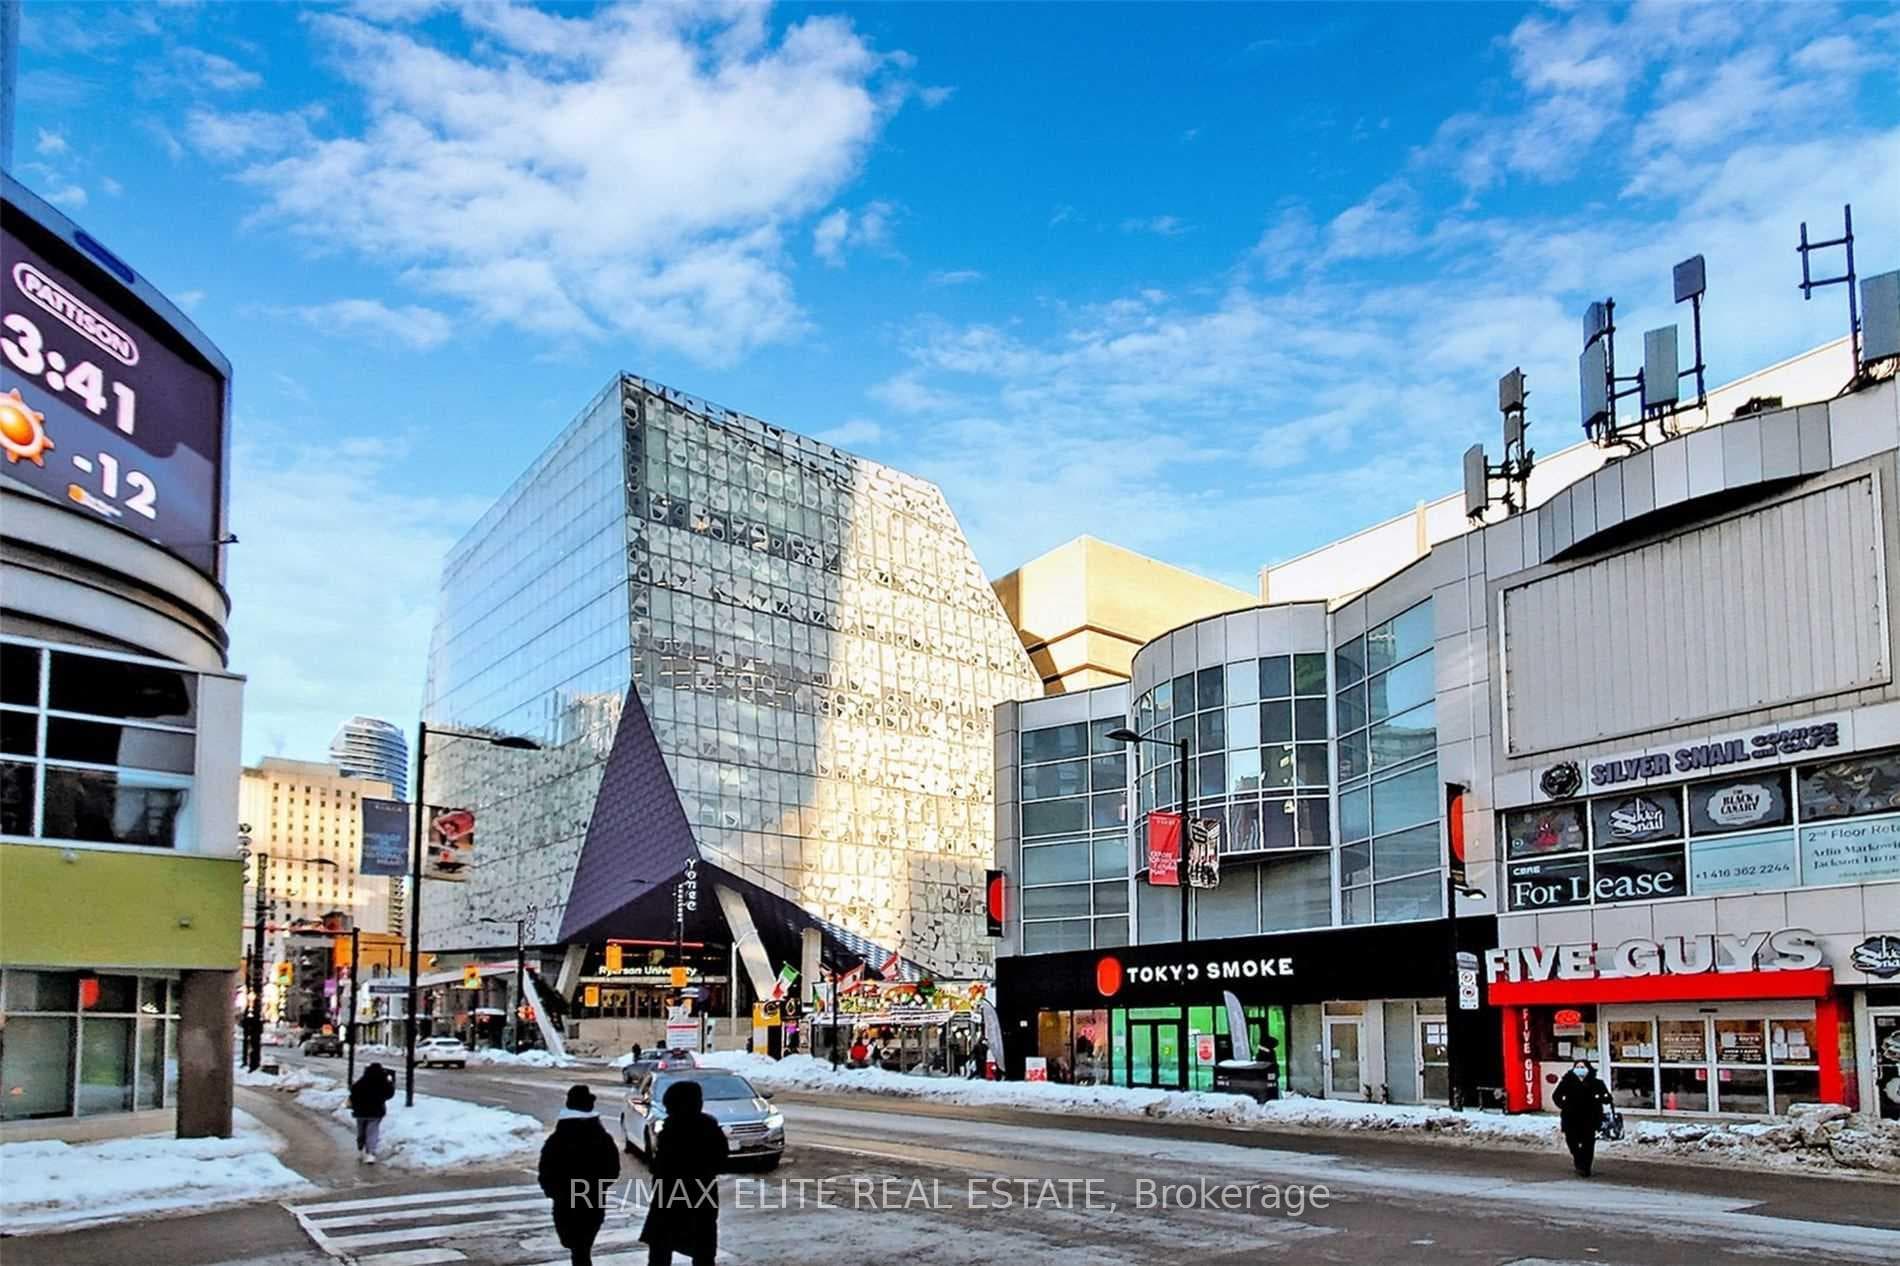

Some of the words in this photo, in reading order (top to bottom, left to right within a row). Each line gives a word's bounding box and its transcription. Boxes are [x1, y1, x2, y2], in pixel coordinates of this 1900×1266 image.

[25, 272, 130, 358] PATTISON
[0, 313, 136, 435] 3:41
[72, 452, 157, 520] -12
[1751, 722, 1838, 747] COMICS
[1590, 753, 1670, 786] SILVER
[1674, 740, 1750, 770] SNAIL
[1831, 828, 1866, 839] Floor
[1513, 881, 1562, 907] For
[1568, 871, 1674, 903] Lease
[644, 965, 699, 977] Univety
[1126, 963, 1200, 984] TOKYO
[1206, 956, 1295, 980] SMOKE
[1484, 942, 1596, 984] FIVE
[1614, 928, 1824, 979] GUYS
[1522, 1008, 1532, 1055] FIVE
[1524, 1058, 1535, 1106] GUYS
